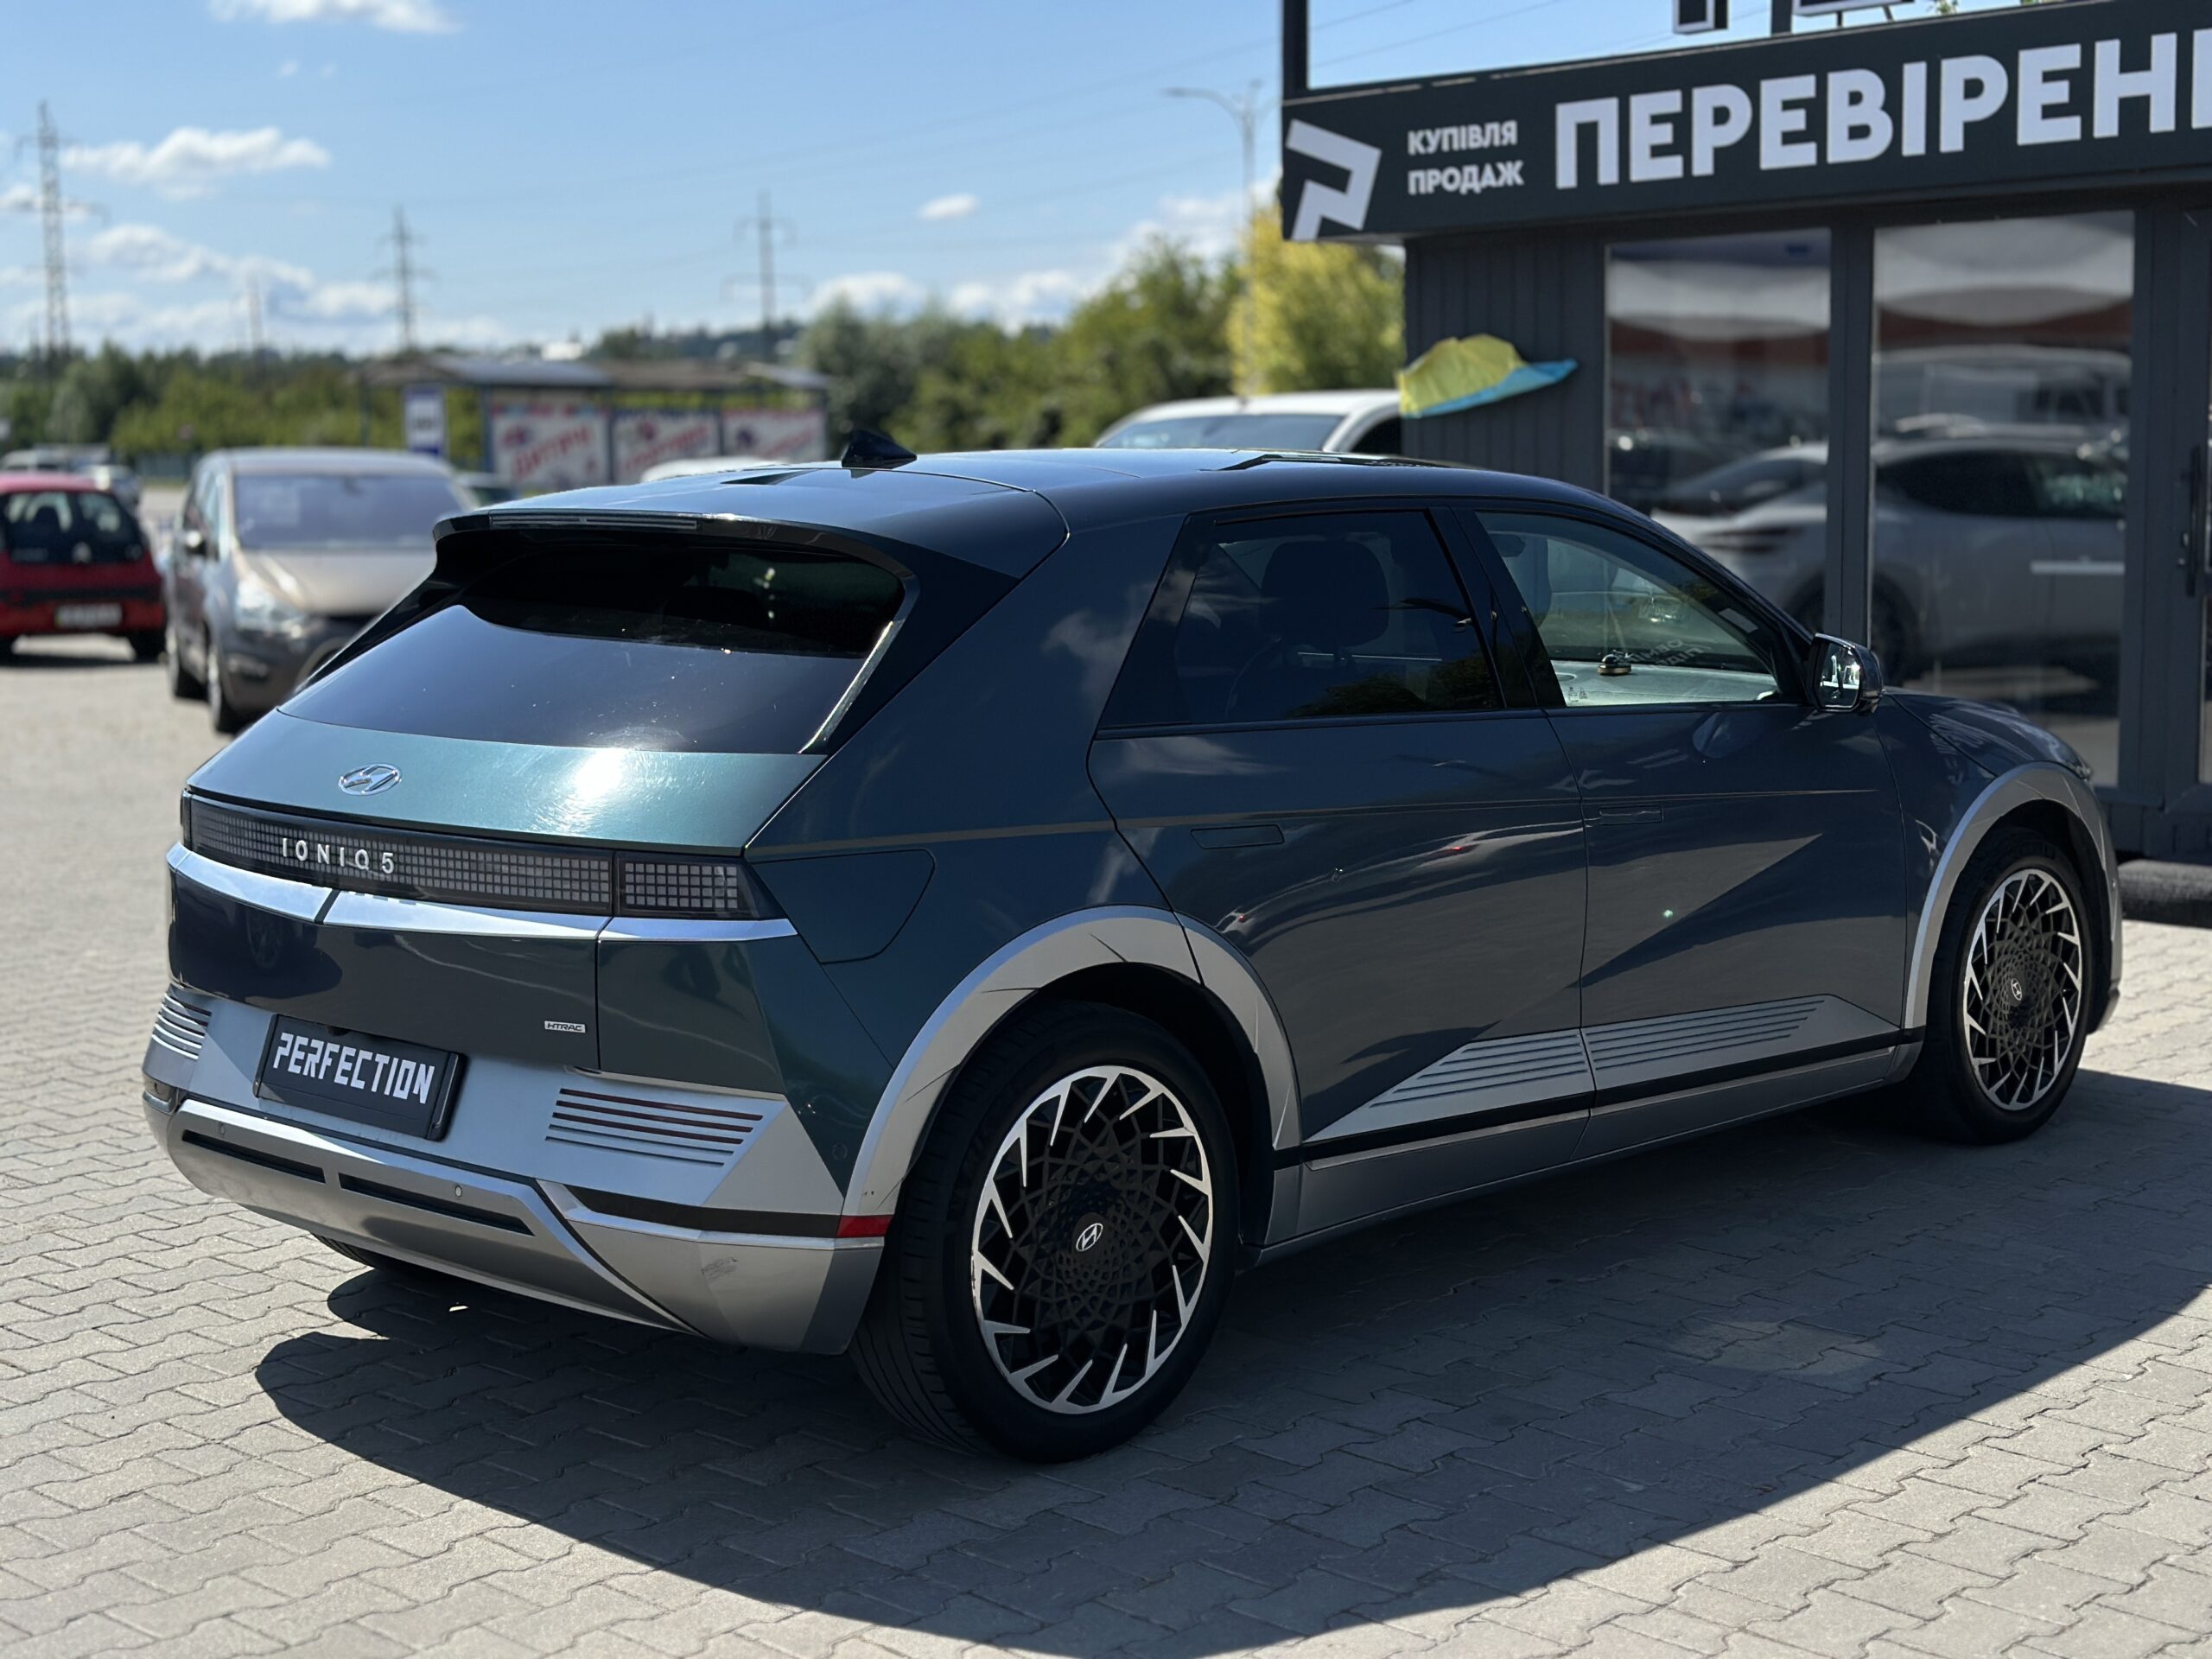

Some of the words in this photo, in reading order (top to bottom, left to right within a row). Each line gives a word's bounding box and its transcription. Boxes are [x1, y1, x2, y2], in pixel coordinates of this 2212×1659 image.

[1407, 120, 1518, 156] КУПІВЛЯ
[1407, 161, 1524, 196] ПРОДАЖ
[283, 837, 370, 871] IONIQ
[381, 851, 395, 874] 5
[547, 1022, 582, 1032] HTRAC
[273, 1032, 435, 1104] PERFECTION
